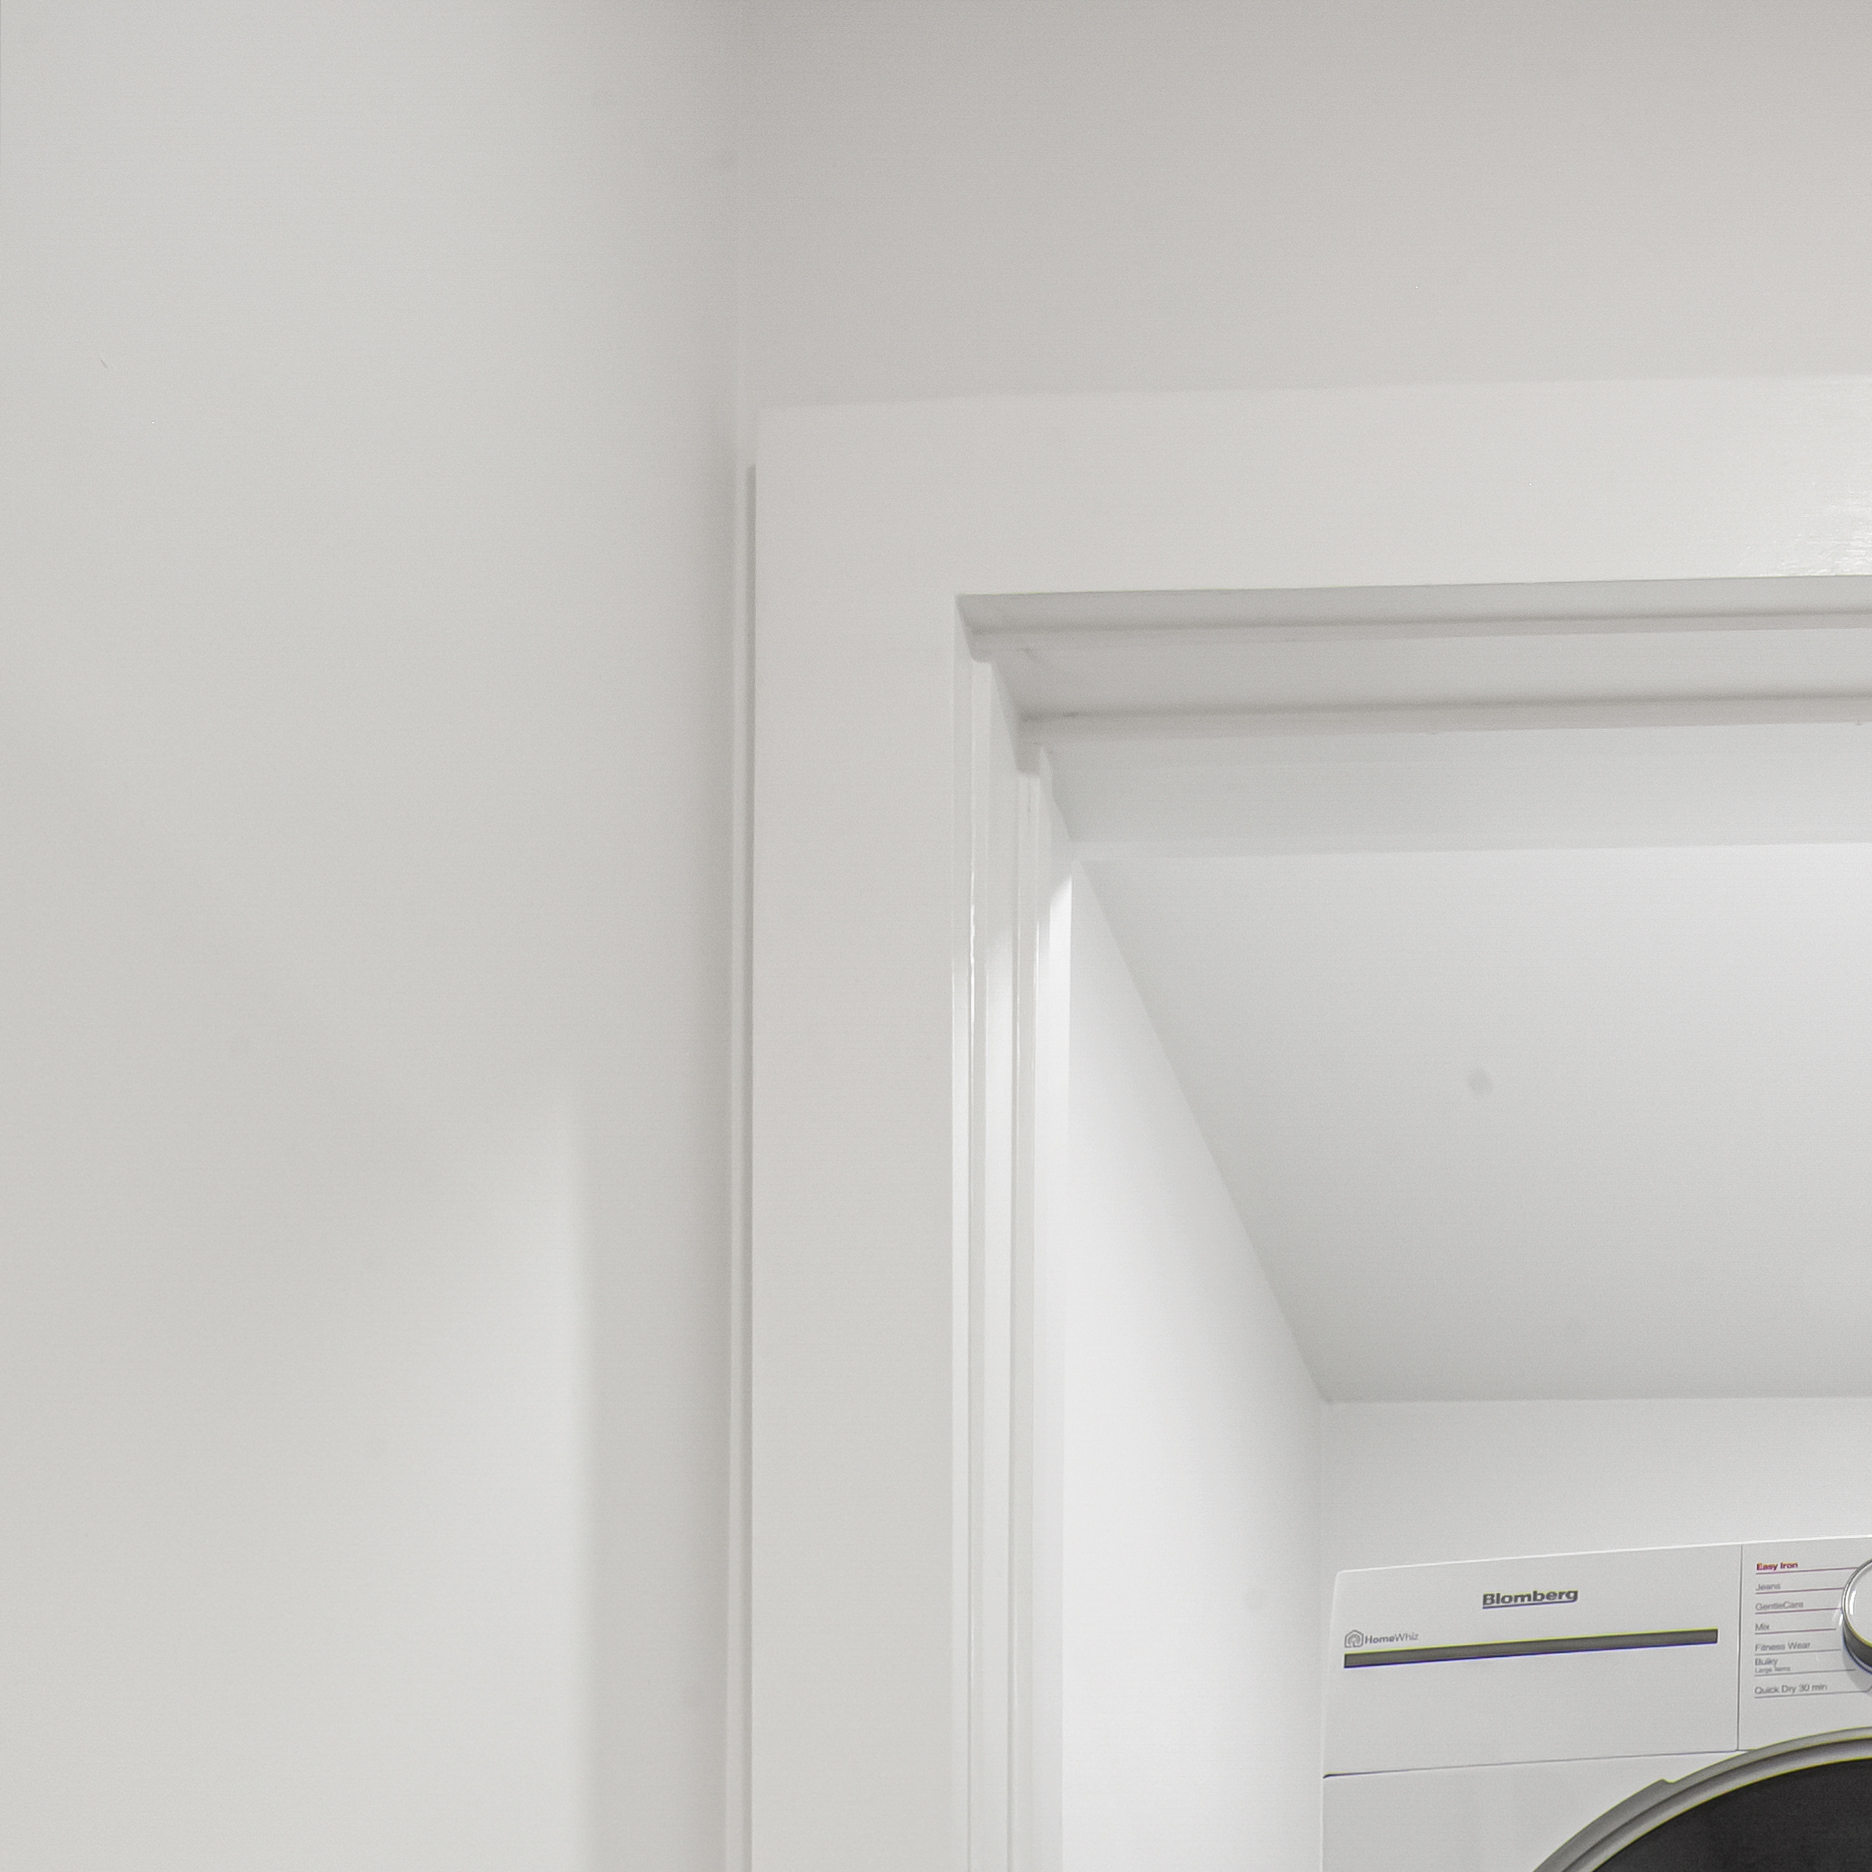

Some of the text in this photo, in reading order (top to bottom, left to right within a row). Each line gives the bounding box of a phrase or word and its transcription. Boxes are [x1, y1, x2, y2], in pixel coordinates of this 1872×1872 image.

[1756, 1562, 1778, 1571] Easy
[1755, 1583, 1781, 1591] Jeans
[1482, 1589, 1578, 1607] Blomberg
[1755, 1623, 1770, 1631] Mix
[1364, 1631, 1419, 1645] HomeWhiz
[1754, 1641, 1811, 1652] Fitness Wear
[1754, 1657, 1778, 1667] Bulky
[1754, 1683, 1828, 1695] Quick Dry 30 min
